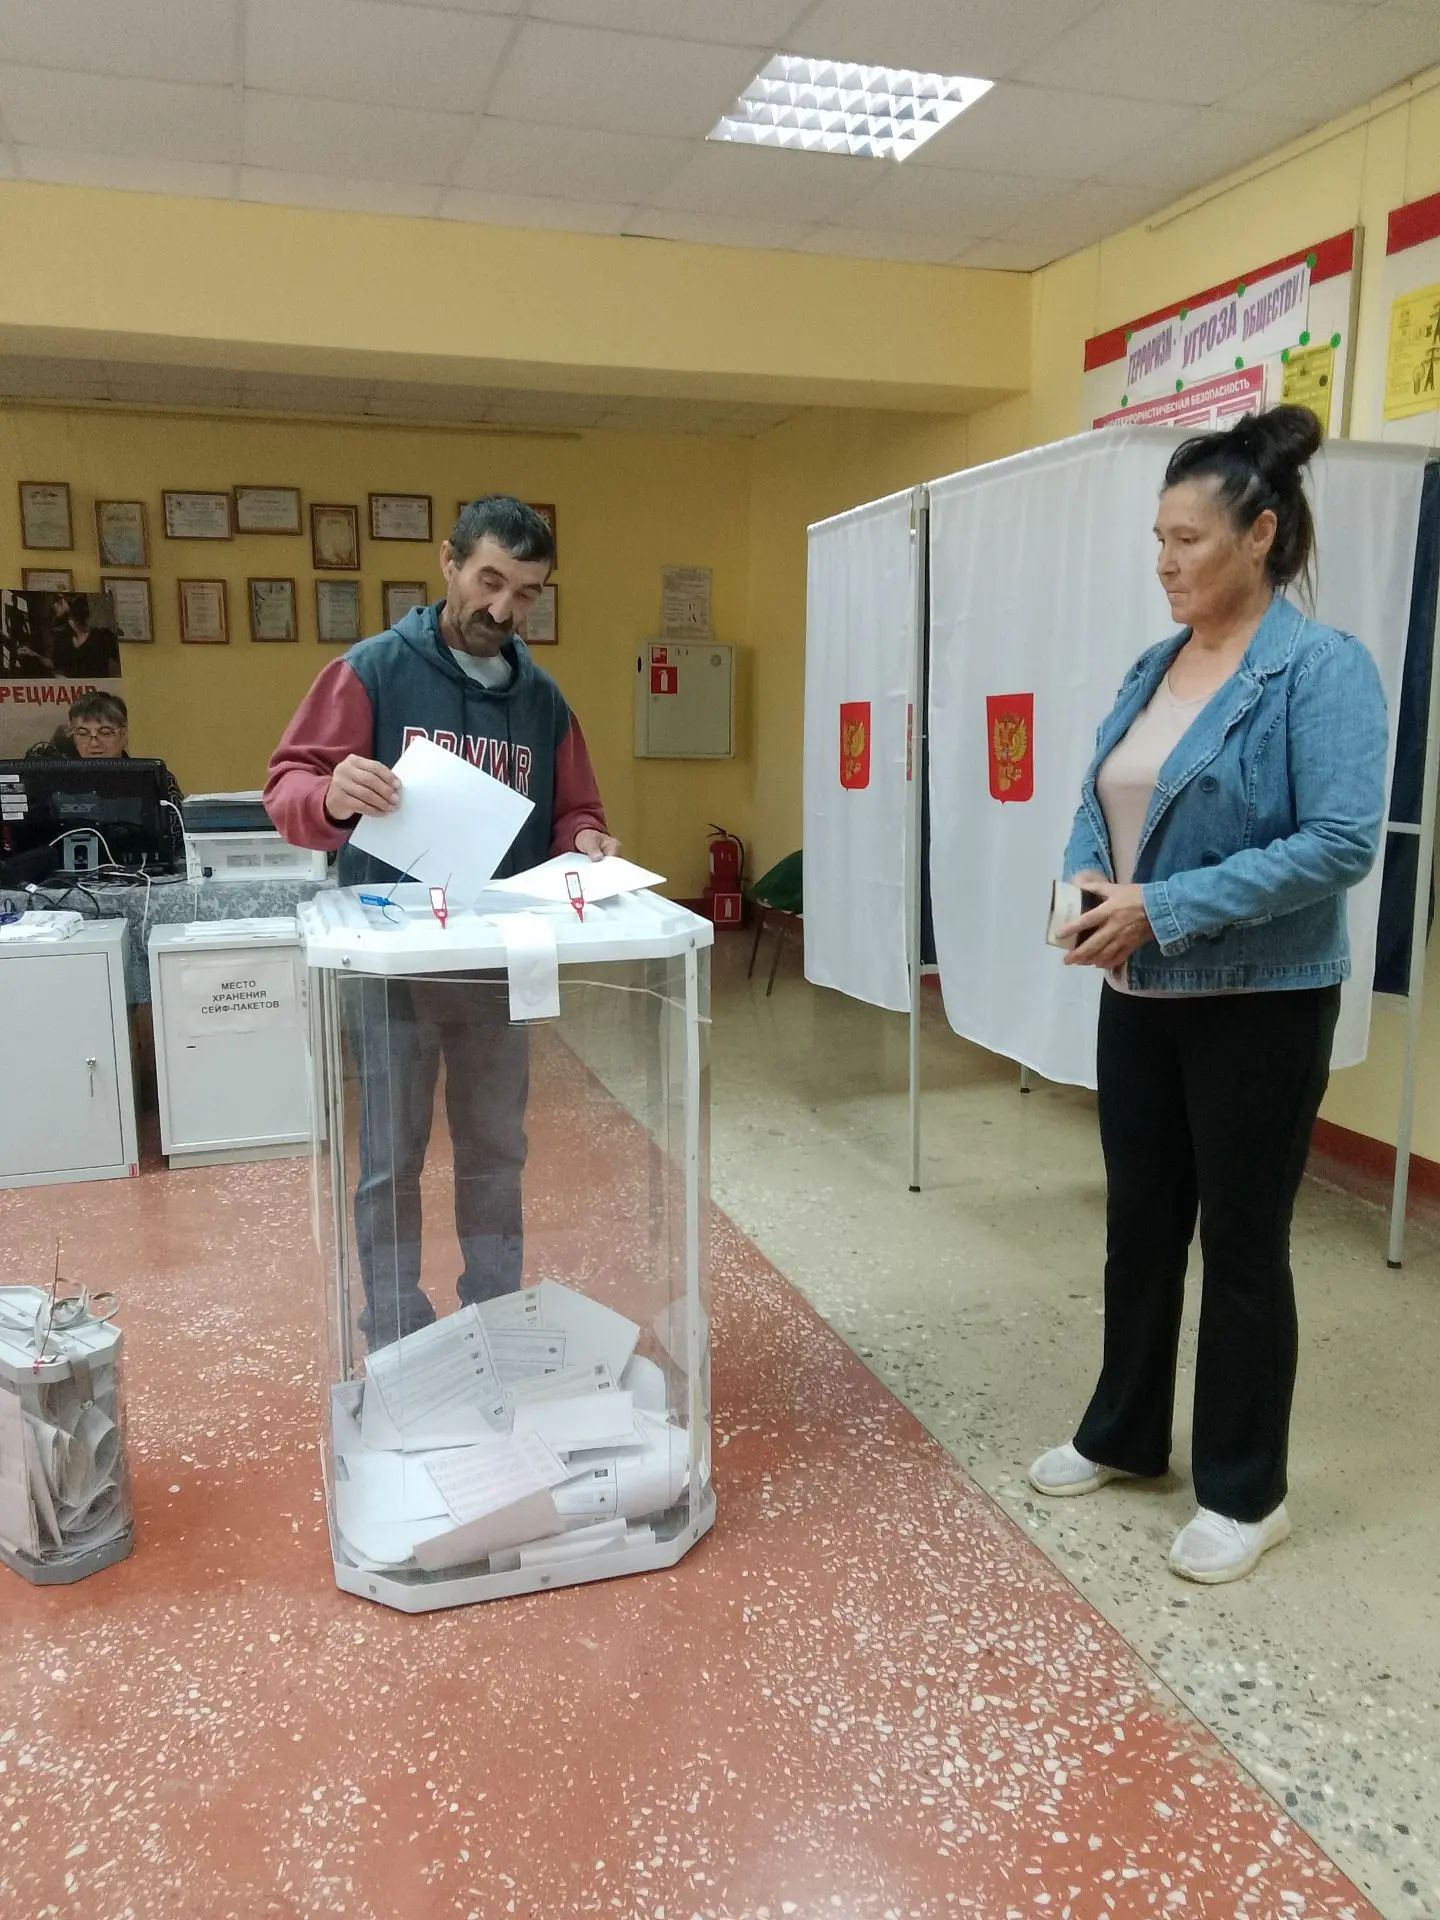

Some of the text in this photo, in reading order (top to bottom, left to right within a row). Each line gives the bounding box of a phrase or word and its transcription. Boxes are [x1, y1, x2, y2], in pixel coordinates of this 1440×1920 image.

[1127, 325, 1173, 387] ТЕРРОРИЗМ
[1182, 301, 1238, 369] УГРОЗА
[1191, 378, 1250, 406] БЕЗОПАСНОСТЬ
[60, 803, 97, 813] acer
[221, 980, 256, 991] МЕСТО
[212, 990, 267, 1002] ХРАНЕНИЯ
[201, 1000, 280, 1014] СЕЙФ-ПАКЕТОВ
